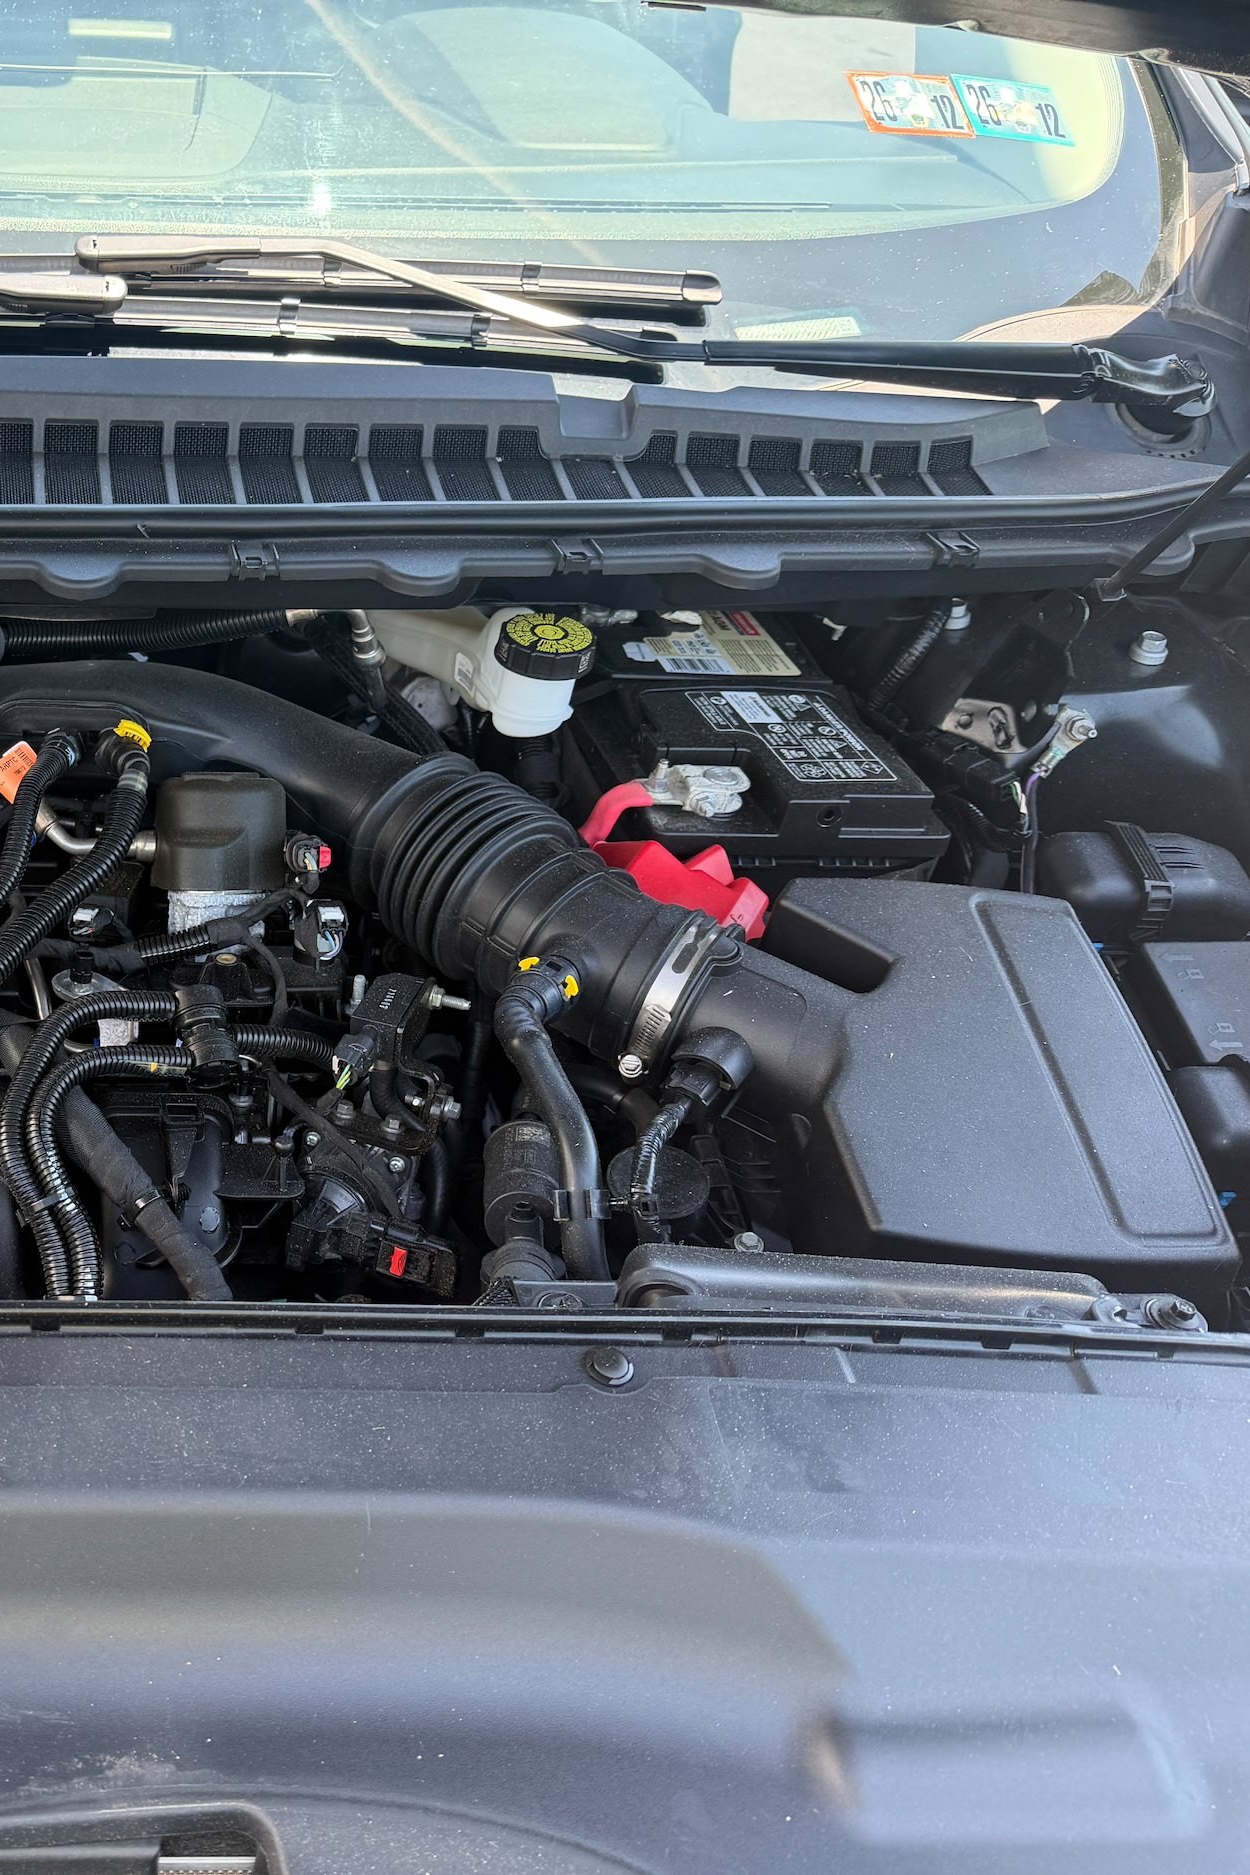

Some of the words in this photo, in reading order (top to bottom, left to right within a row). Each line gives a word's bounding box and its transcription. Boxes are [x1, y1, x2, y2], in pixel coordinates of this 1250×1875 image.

[859, 80, 898, 122] 26
[930, 94, 965, 130] 12
[965, 84, 1002, 127] 26
[1035, 102, 1067, 138] 12
